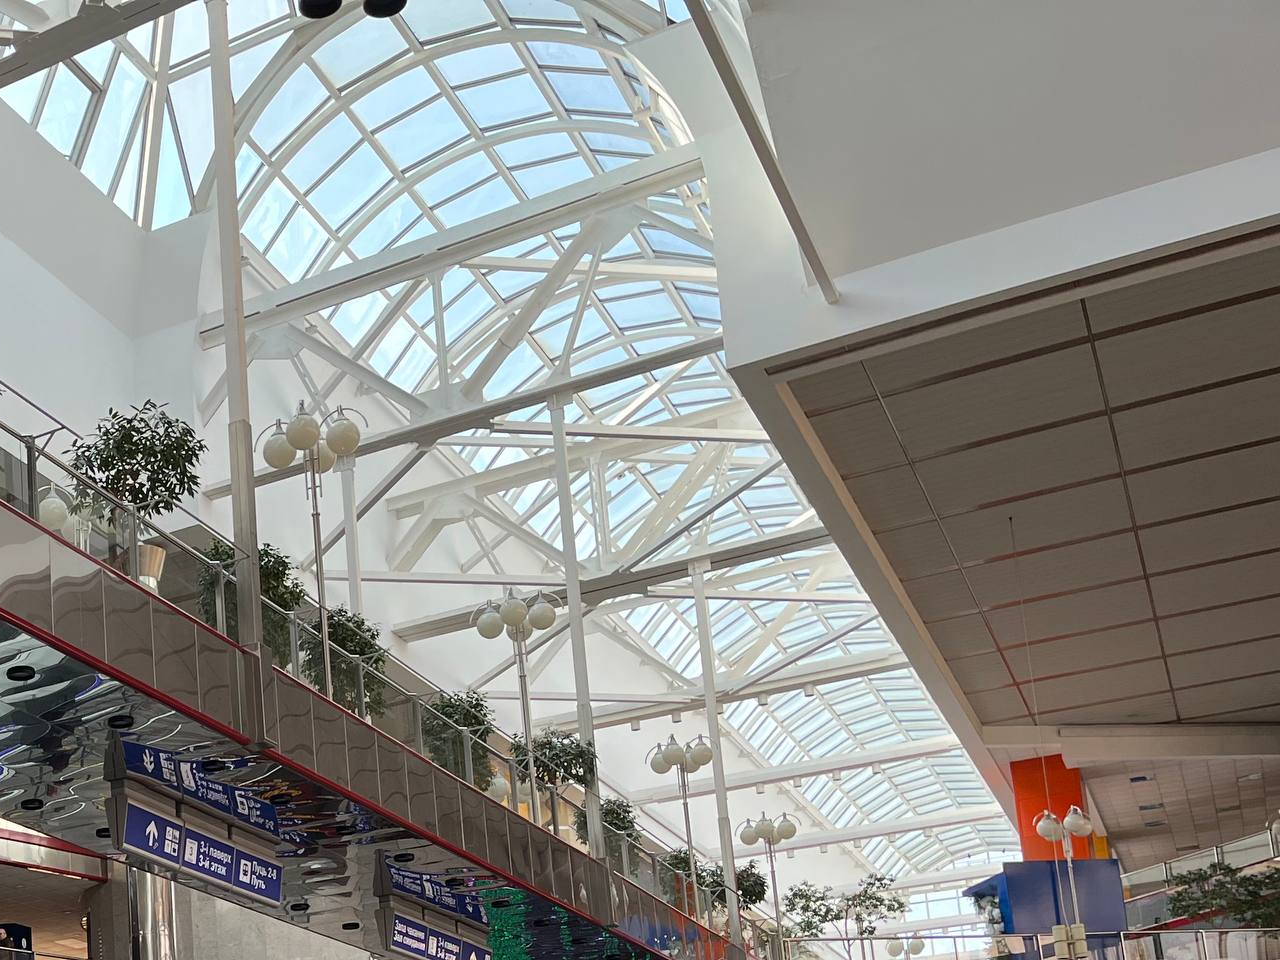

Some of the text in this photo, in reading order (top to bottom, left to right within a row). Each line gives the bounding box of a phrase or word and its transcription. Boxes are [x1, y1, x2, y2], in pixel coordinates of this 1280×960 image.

[209, 845, 232, 864] паверх
[210, 860, 227, 876] этаж
[252, 861, 267, 878] Пуць
[251, 878, 266, 890] Путь
